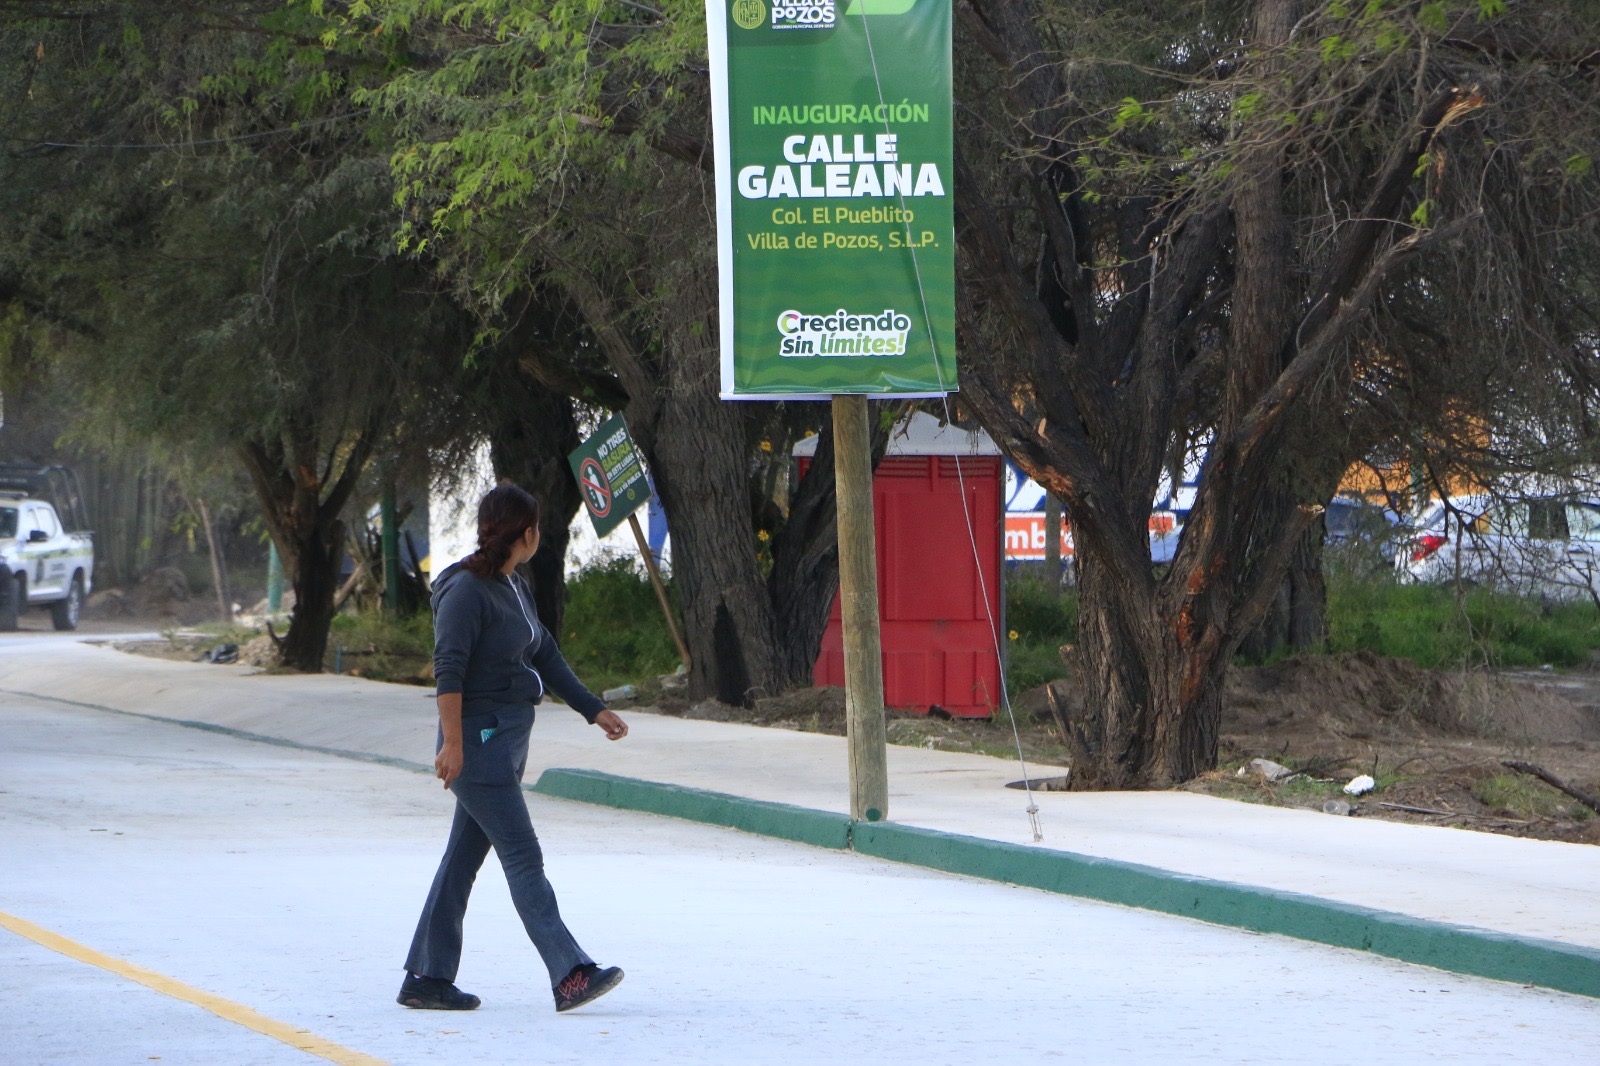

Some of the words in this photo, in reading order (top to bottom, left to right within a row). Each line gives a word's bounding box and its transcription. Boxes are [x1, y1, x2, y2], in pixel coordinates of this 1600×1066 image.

[753, 98, 929, 125] INAUGURACIÓN
[783, 134, 898, 163] CALLE
[738, 163, 945, 199] GALEANA
[772, 208, 807, 224] Col.
[813, 208, 829, 223] El
[836, 207, 914, 223] Pueblito
[748, 233, 789, 249] Villa
[795, 233, 817, 249] de
[824, 233, 883, 251] Pozos,
[889, 231, 939, 248] S.L.P.
[781, 312, 909, 333] Creciendo
[820, 333, 905, 354] límites!
[597, 443, 608, 459] NO
[607, 427, 626, 451] TIRES
[601, 440, 631, 472] BASURA
